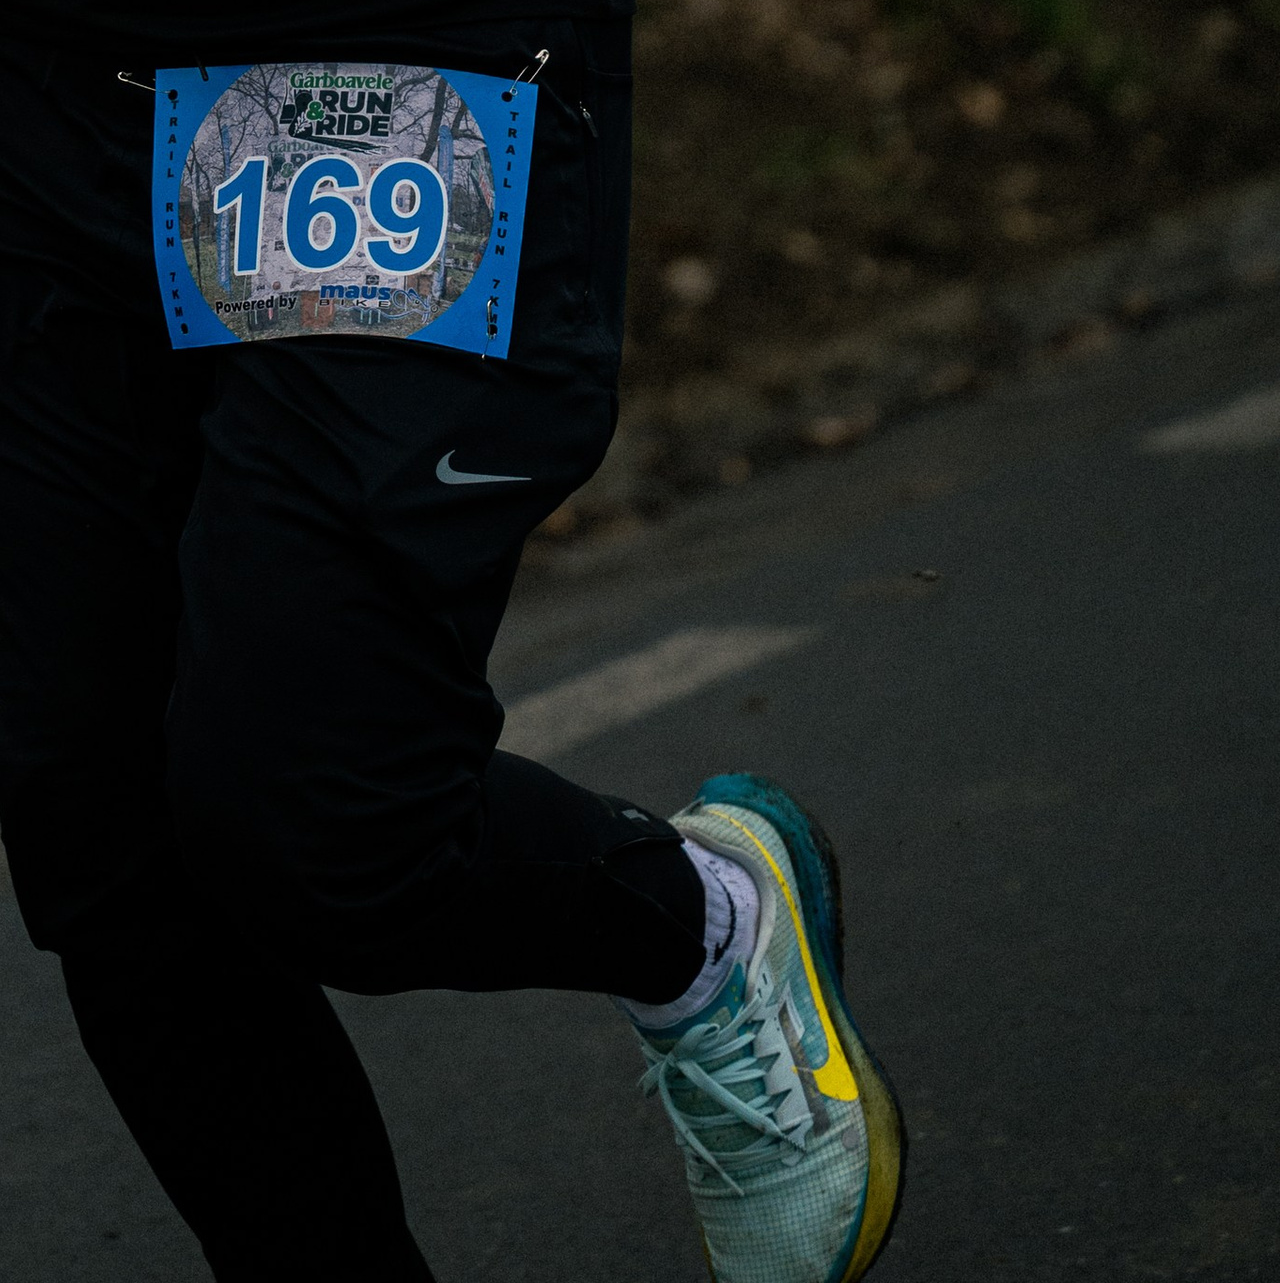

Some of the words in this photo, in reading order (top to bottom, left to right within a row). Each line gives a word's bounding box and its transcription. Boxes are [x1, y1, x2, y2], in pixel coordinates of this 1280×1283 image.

[290, 71, 393, 89] Gârboavele
[306, 101, 325, 121] &
[319, 90, 393, 115] RUN
[315, 114, 391, 137] RIDE
[167, 100, 179, 178] TRAIL
[503, 111, 519, 189] TRAIL
[166, 202, 175, 247] RUN
[214, 154, 449, 276] 169
[495, 211, 509, 256] RUN
[170, 272, 184, 317] 7KM
[319, 299, 390, 308] BIKE
[320, 284, 391, 300] maus
[215, 296, 274, 314] Powered
[279, 296, 297, 310] by
